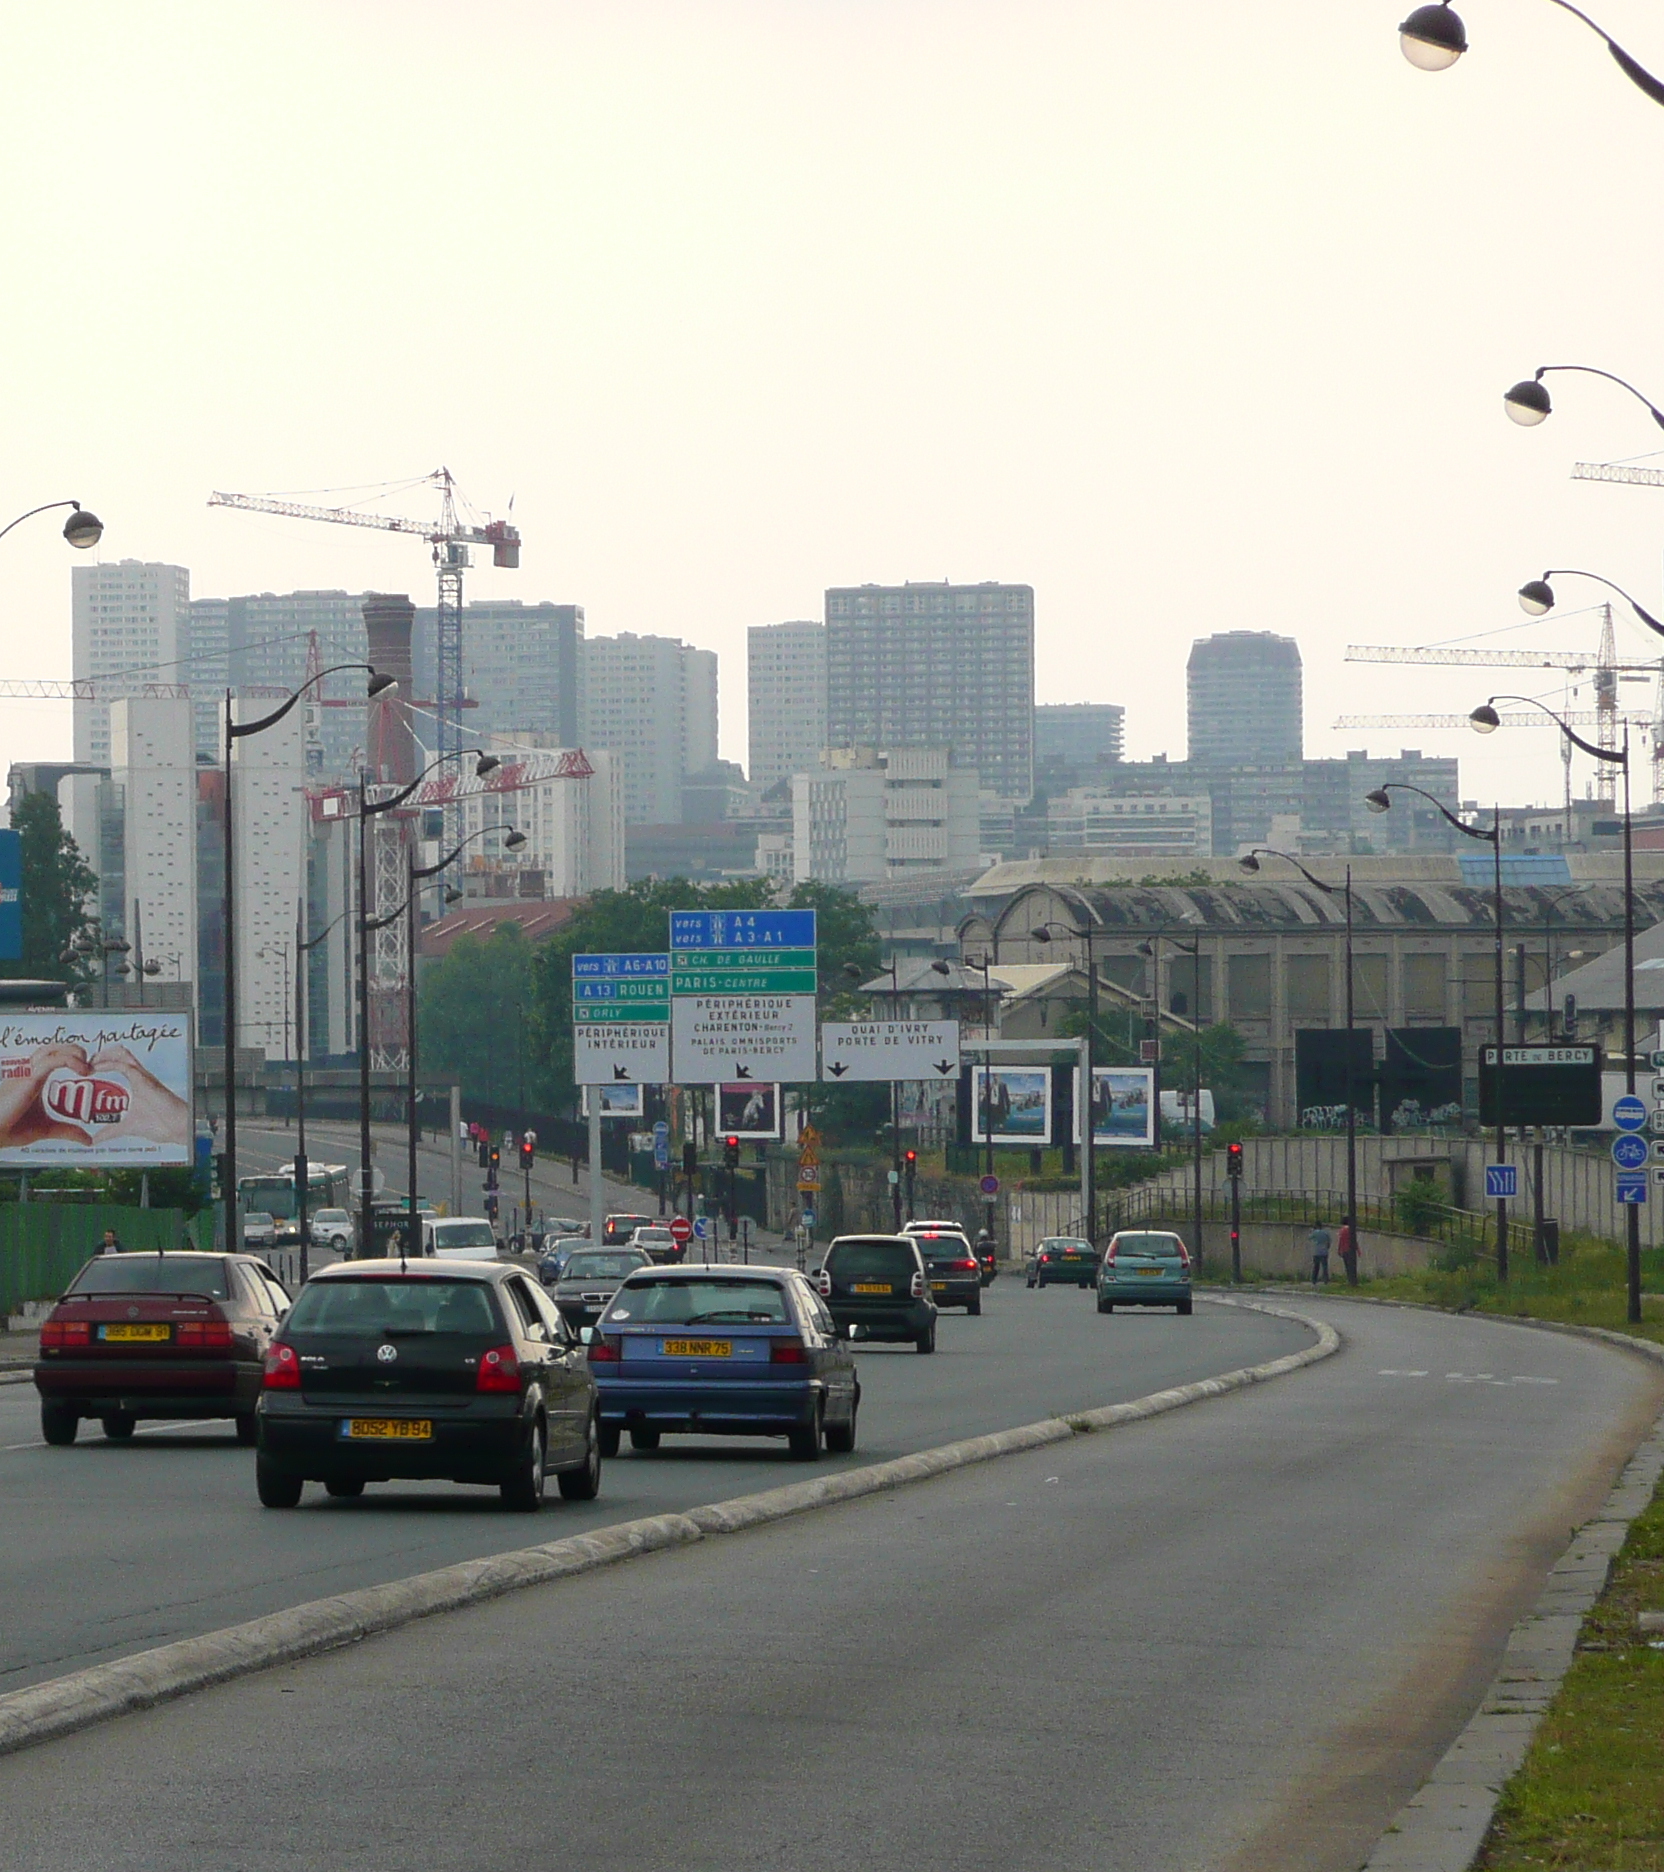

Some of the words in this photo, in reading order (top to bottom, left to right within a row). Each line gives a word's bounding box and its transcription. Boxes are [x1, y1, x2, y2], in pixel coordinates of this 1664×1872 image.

[676, 919, 702, 928] vers
[676, 934, 702, 943] vers
[717, 955, 731, 964] DE
[738, 954, 780, 964] GAULLE
[577, 962, 600, 972] vers
[620, 984, 663, 996] ROUEN
[697, 998, 792, 1009] PÉRIPHÉRIQUE
[593, 1008, 622, 1018] ORLY
[709, 1010, 779, 1021] EXTÉRIEUR
[577, 1027, 667, 1038] PÉRIPHÉRIQUE
[852, 1025, 880, 1035] QUAI
[888, 1024, 929, 1034] D'IVRY
[0, 1025, 90, 1048] l'émotion
[91, 1021, 183, 1053] partagée
[691, 1038, 726, 1046] PALAIS
[731, 1036, 798, 1046] OMNISPORTS
[838, 1037, 876, 1046] PORTE
[884, 1036, 899, 1046] DE
[908, 1035, 944, 1045] VITRY
[587, 1038, 657, 1049] INTÉRIEUR
[703, 1047, 715, 1055] DE
[1487, 1050, 1528, 1061] PRTE
[1548, 1049, 1590, 1061] BERCY
[0, 1066, 31, 1078] radio
[665, 1341, 687, 1354] 338
[689, 1341, 713, 1354] NNR
[714, 1341, 729, 1355] 75
[411, 1421, 429, 1436] 94
